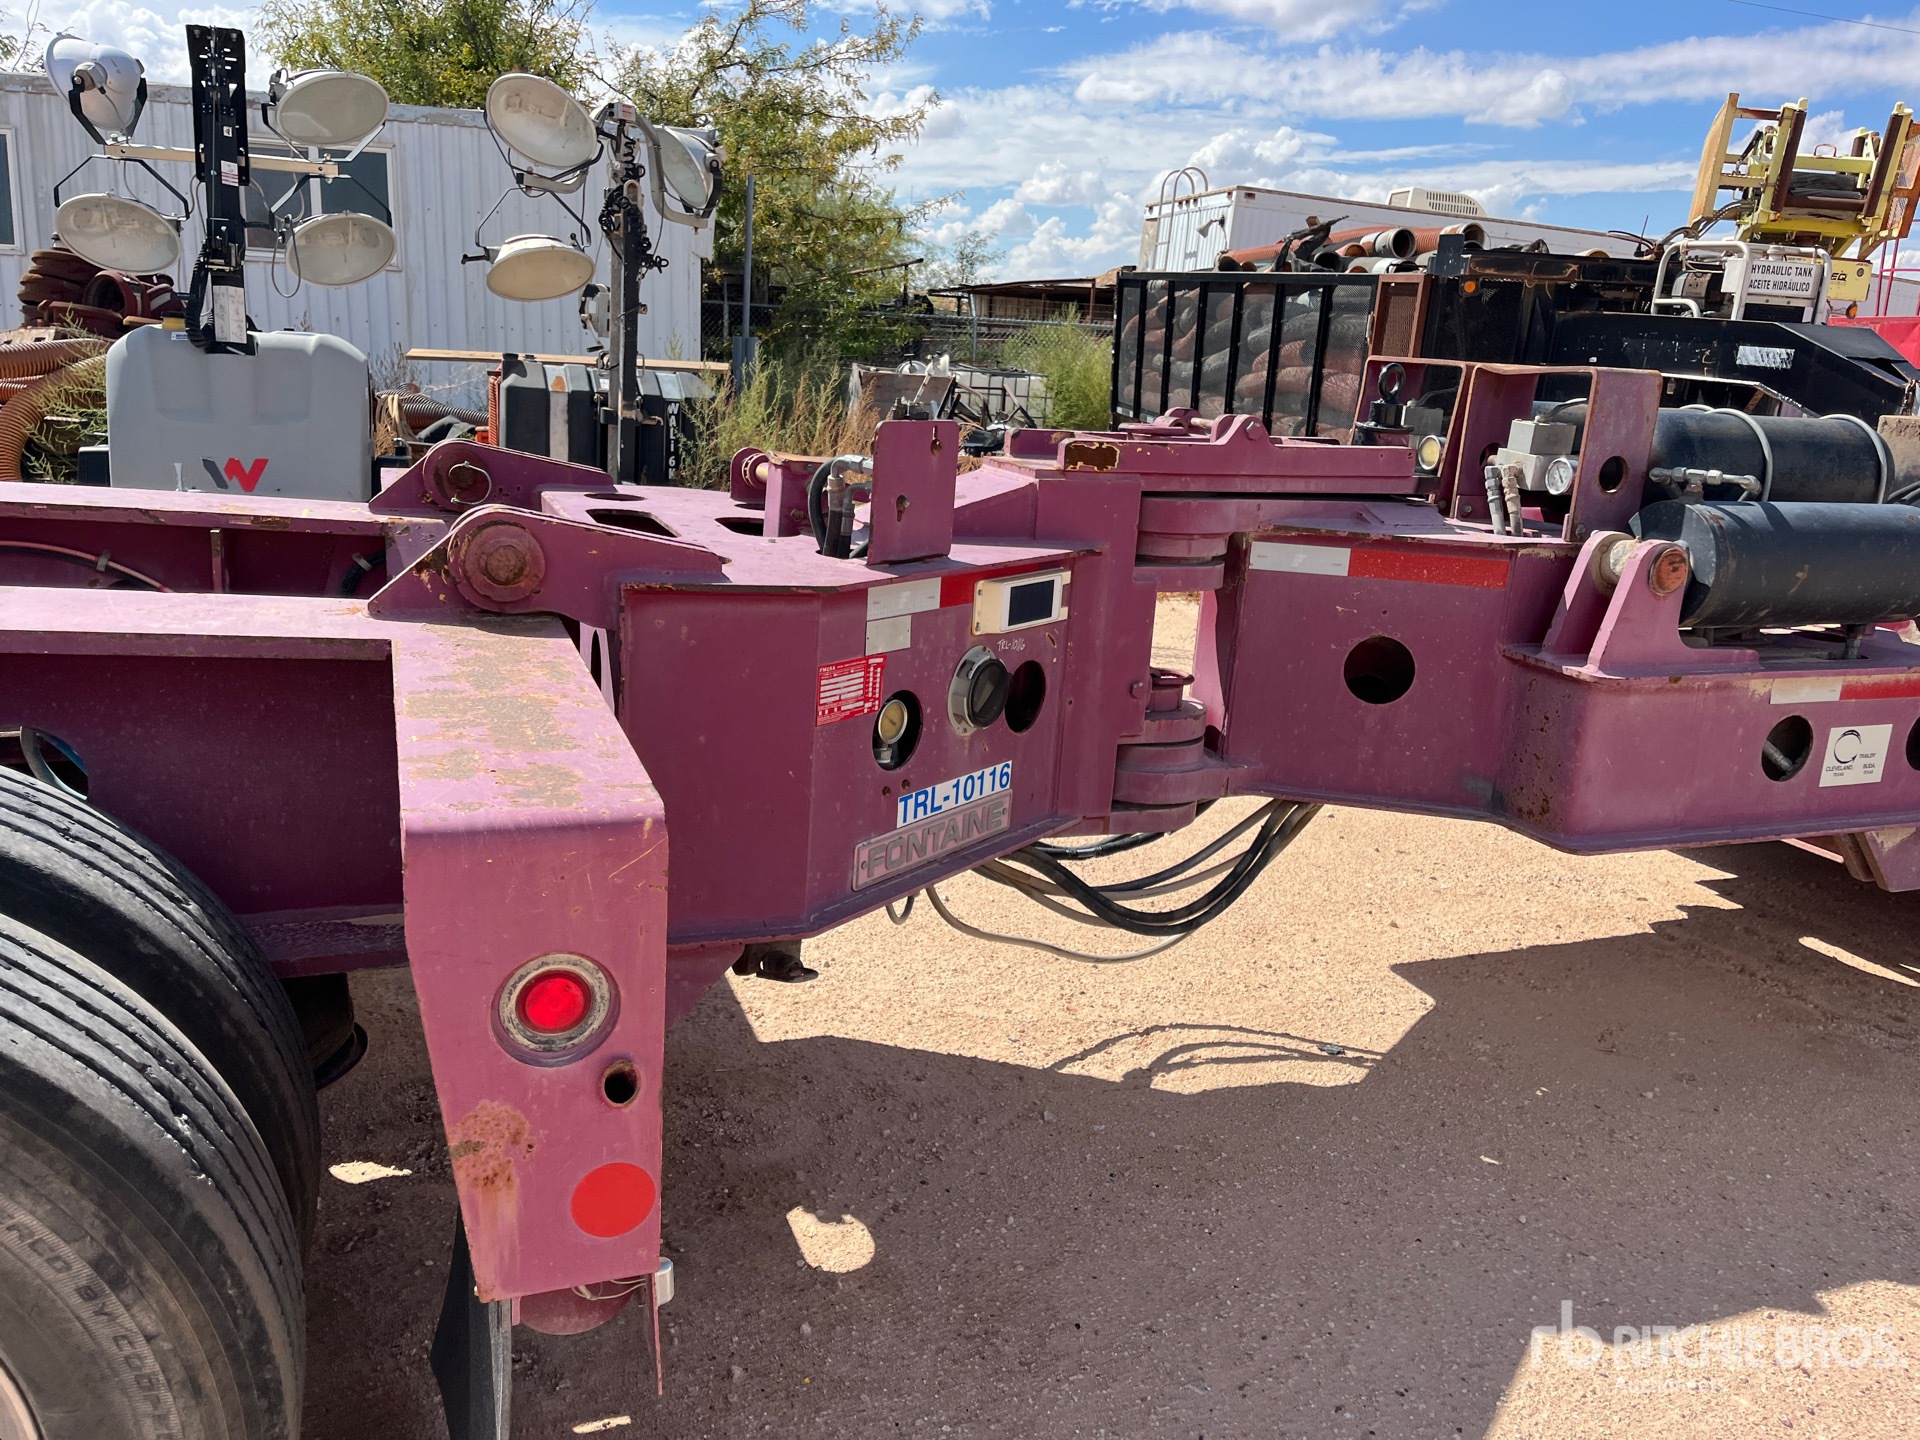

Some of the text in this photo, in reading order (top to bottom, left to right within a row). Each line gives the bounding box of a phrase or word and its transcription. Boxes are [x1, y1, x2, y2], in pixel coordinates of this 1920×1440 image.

[1751, 264, 1813, 278] HYDRAULIC TANK
[1748, 279, 1770, 290] ACEITE
[1825, 764, 1853, 772] CLEVELAND
[898, 762, 1011, 824] TRL-10116
[867, 801, 1004, 878] FONTAINE
